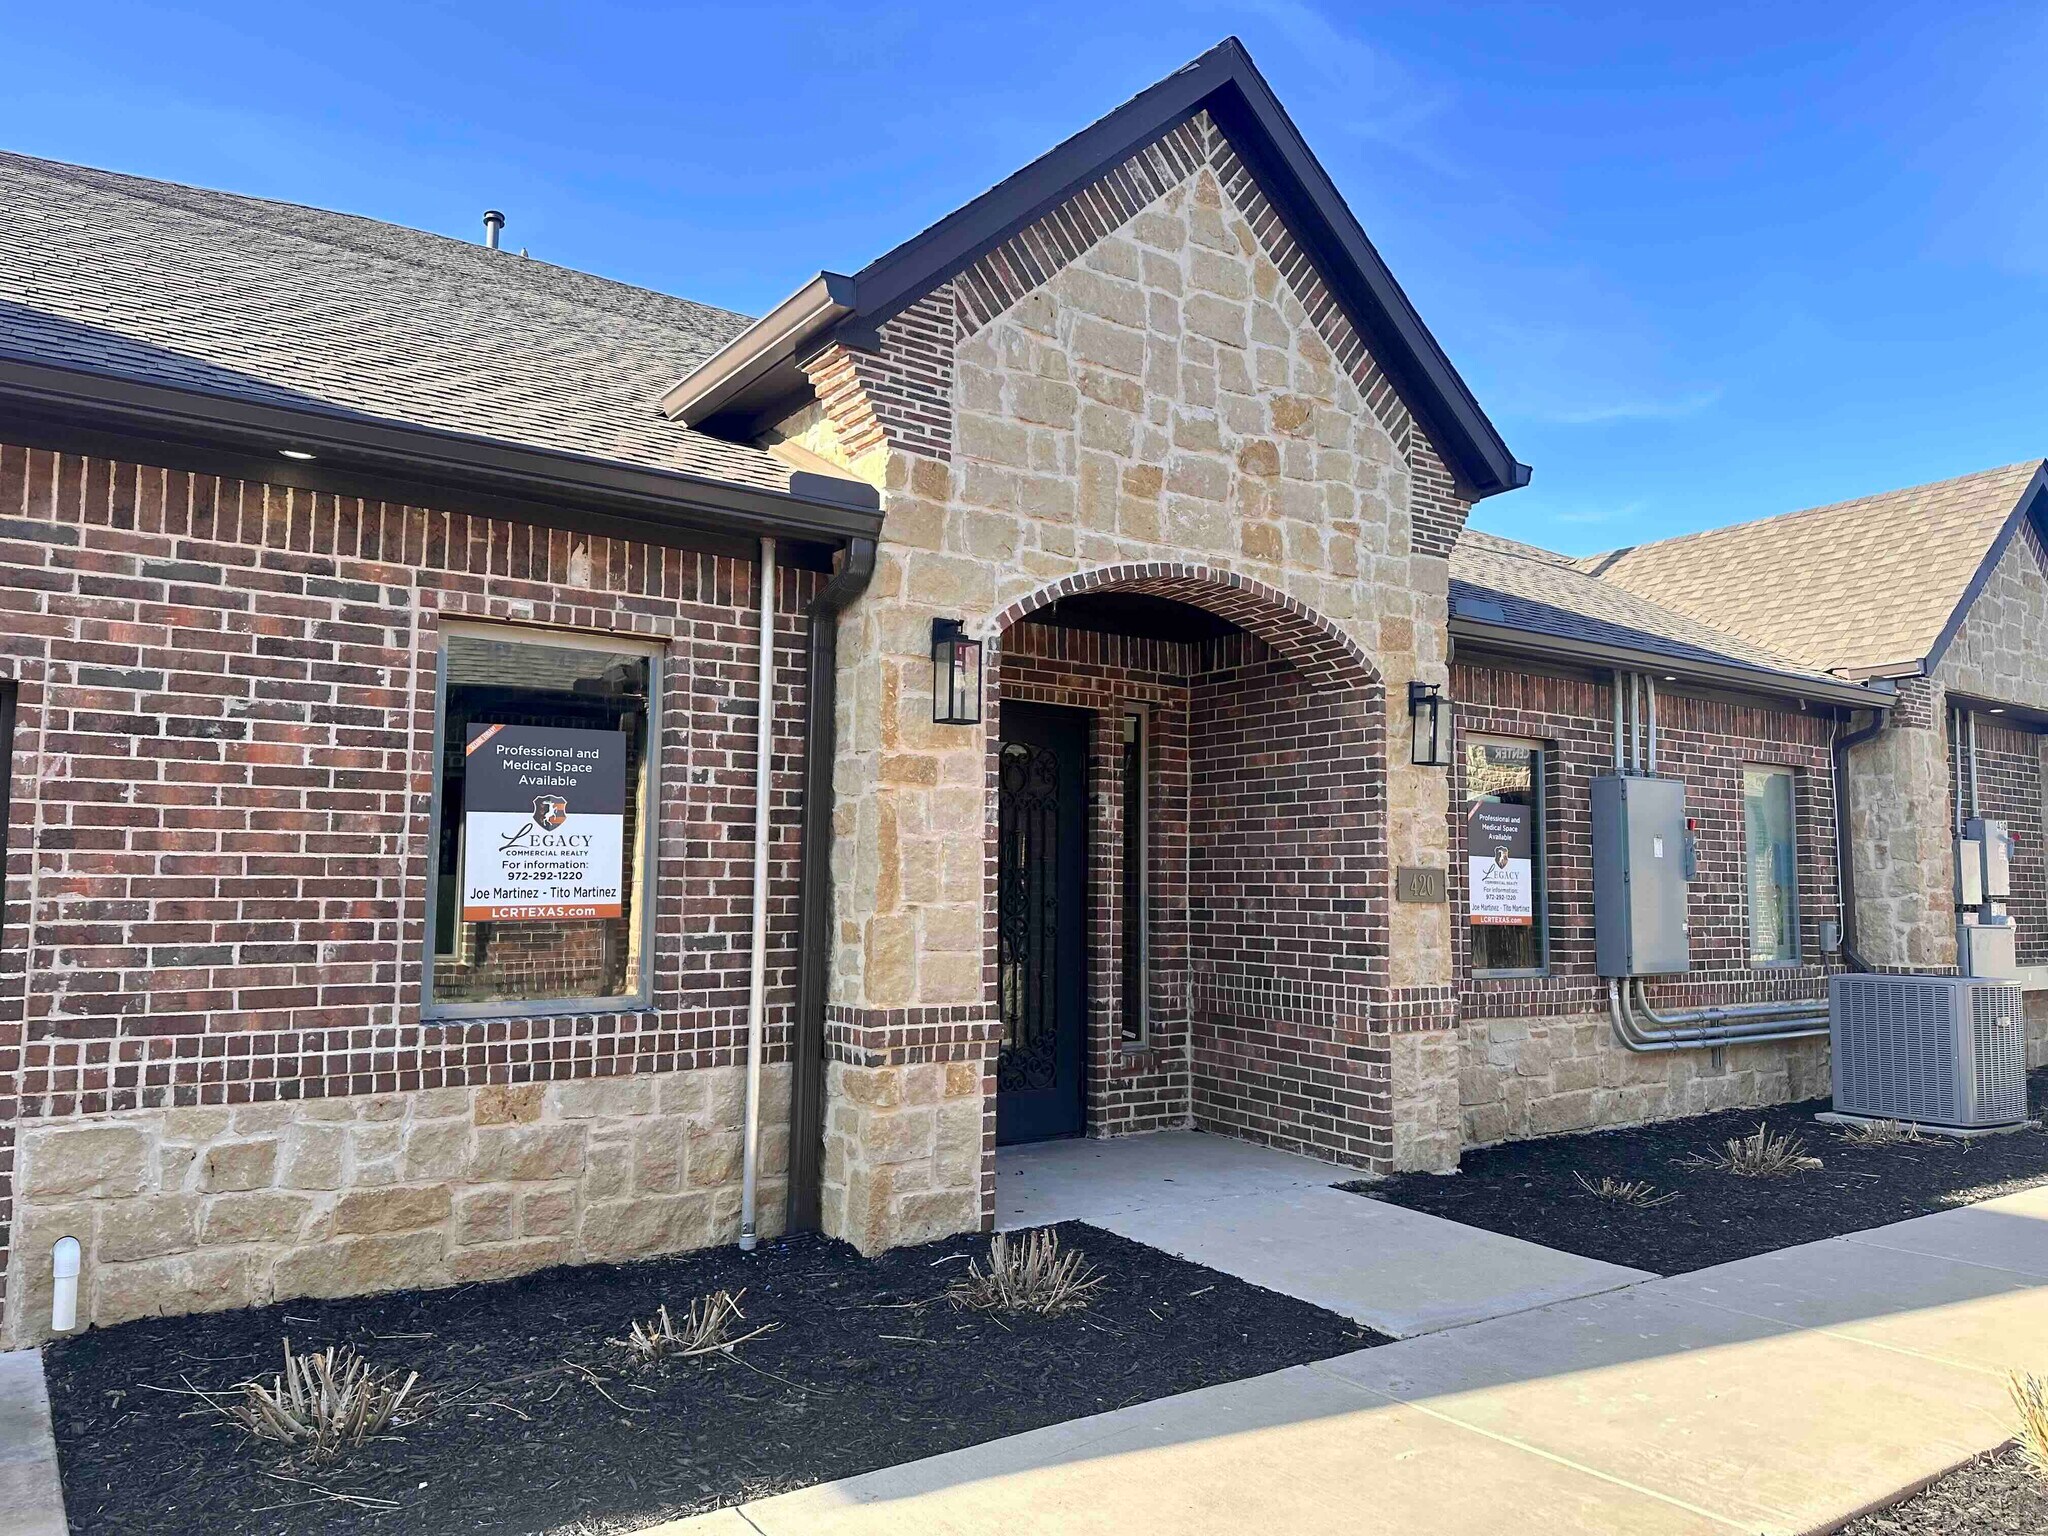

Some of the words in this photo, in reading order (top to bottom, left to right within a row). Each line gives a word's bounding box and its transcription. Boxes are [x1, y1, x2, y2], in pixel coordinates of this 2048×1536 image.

[496, 744, 573, 758] Professional
[576, 749, 599, 758] and
[503, 760, 551, 771] Medical
[555, 762, 592, 773] Space
[518, 775, 577, 786] Available
[1479, 814, 1510, 823] Professional
[499, 822, 593, 852] LEGACY
[502, 860, 521, 869] For
[524, 860, 589, 869] information:
[508, 872, 583, 880] 972-292-1220
[1482, 864, 1520, 881] LEGACY
[1410, 874, 1434, 896] 420
[470, 888, 490, 900] Joe
[493, 887, 538, 899] Martinez
[550, 887, 570, 898] Tito
[574, 886, 616, 898] Martinez
[492, 907, 596, 918] LCRTEXAS.com
